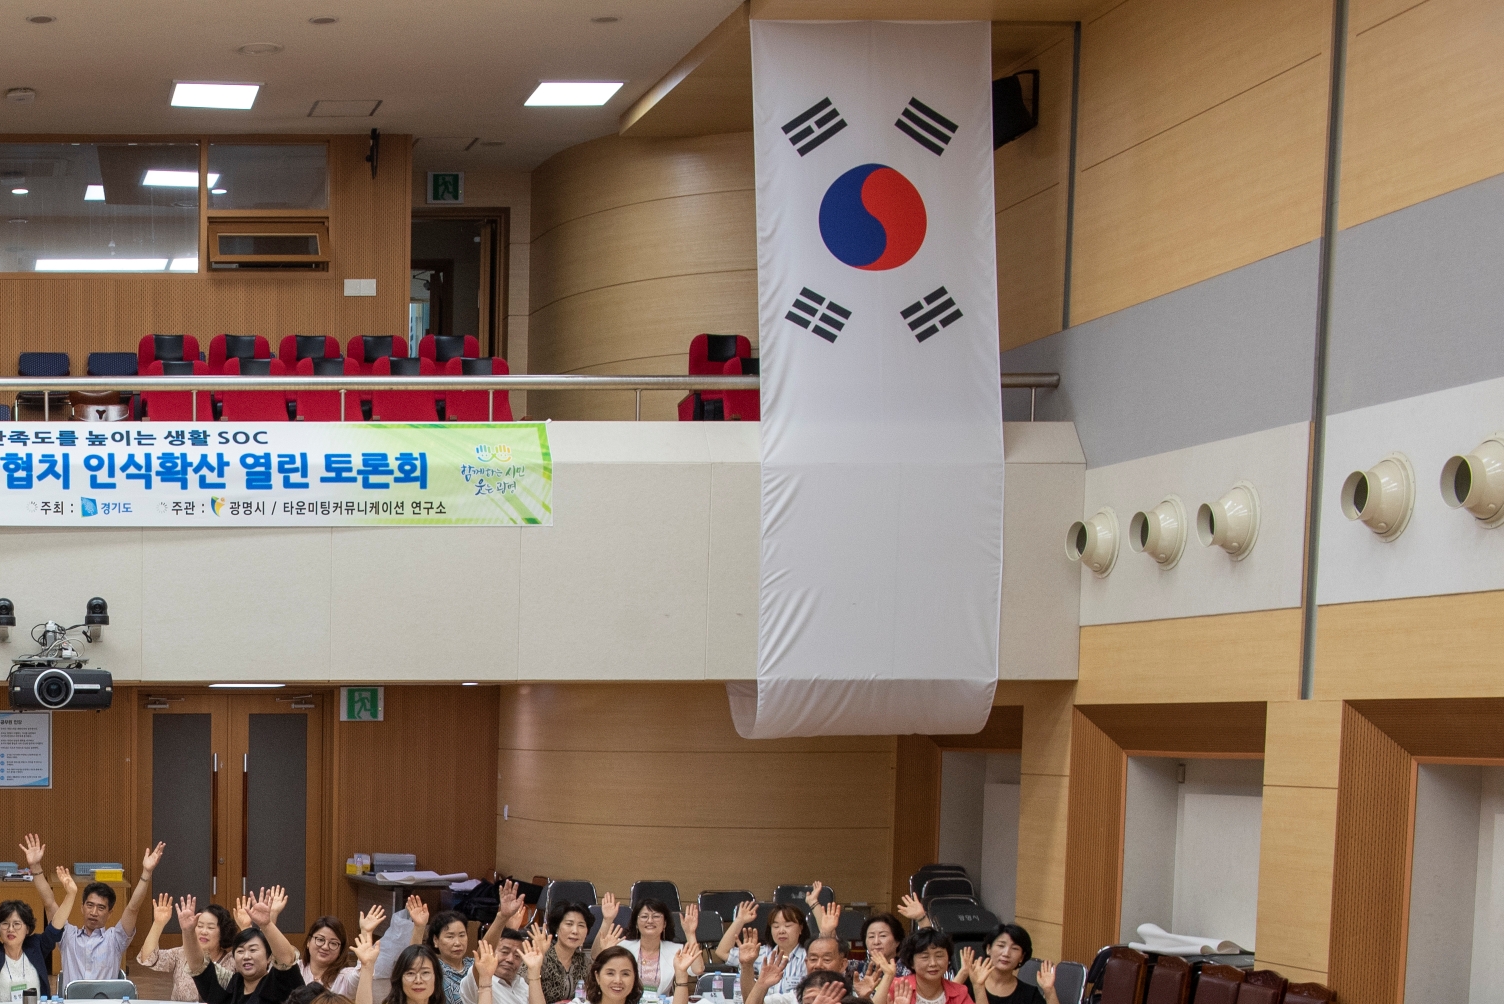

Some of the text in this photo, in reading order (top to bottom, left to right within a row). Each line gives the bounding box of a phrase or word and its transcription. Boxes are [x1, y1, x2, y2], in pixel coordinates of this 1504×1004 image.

[85, 430, 157, 447] 높이는
[163, 430, 211, 447] 생활
[217, 431, 269, 445] SOC
[83, 452, 231, 491] 인식확산
[239, 452, 310, 491] 열린
[319, 452, 428, 491] 토론회
[505, 464, 526, 479] 시민
[496, 480, 517, 495] 광명
[40, 501, 64, 516] 주최
[101, 502, 133, 515] 경기도
[171, 501, 196, 516] 주관
[229, 500, 265, 516] 광명시
[283, 500, 405, 516] 타운미팅커뮤니케이션
[410, 500, 447, 516] 연구소
